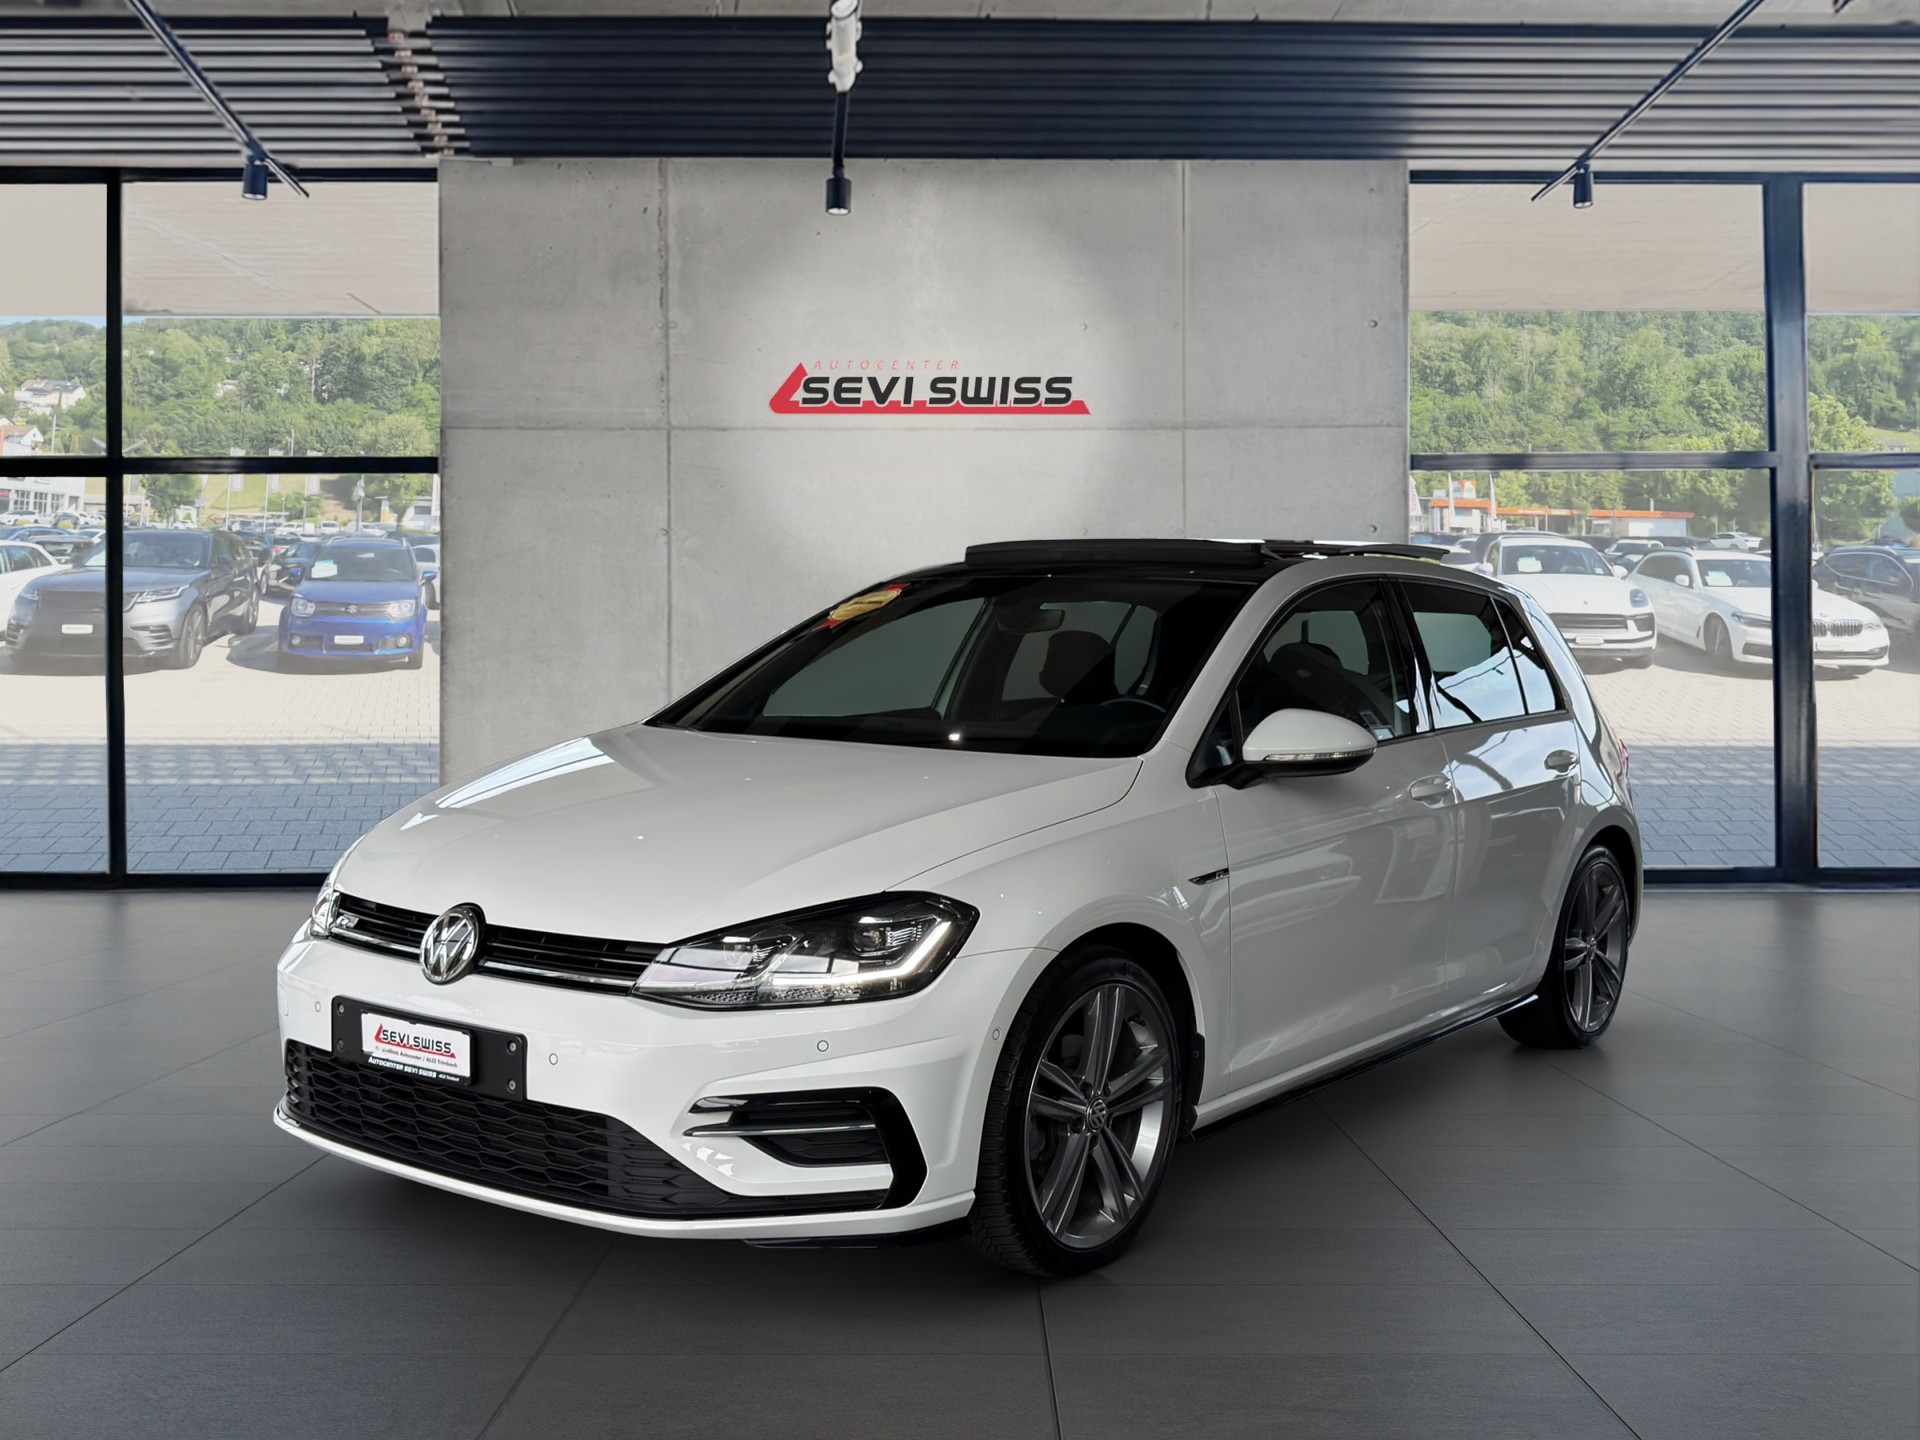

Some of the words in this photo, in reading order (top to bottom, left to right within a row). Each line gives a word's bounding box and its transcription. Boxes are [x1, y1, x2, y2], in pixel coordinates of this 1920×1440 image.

[813, 360, 960, 371] AUTOCENTER
[801, 376, 914, 405] SEVI
[928, 376, 1073, 405] SWISS
[382, 1029, 410, 1045] SEVI
[413, 1036, 452, 1054] SWISS
